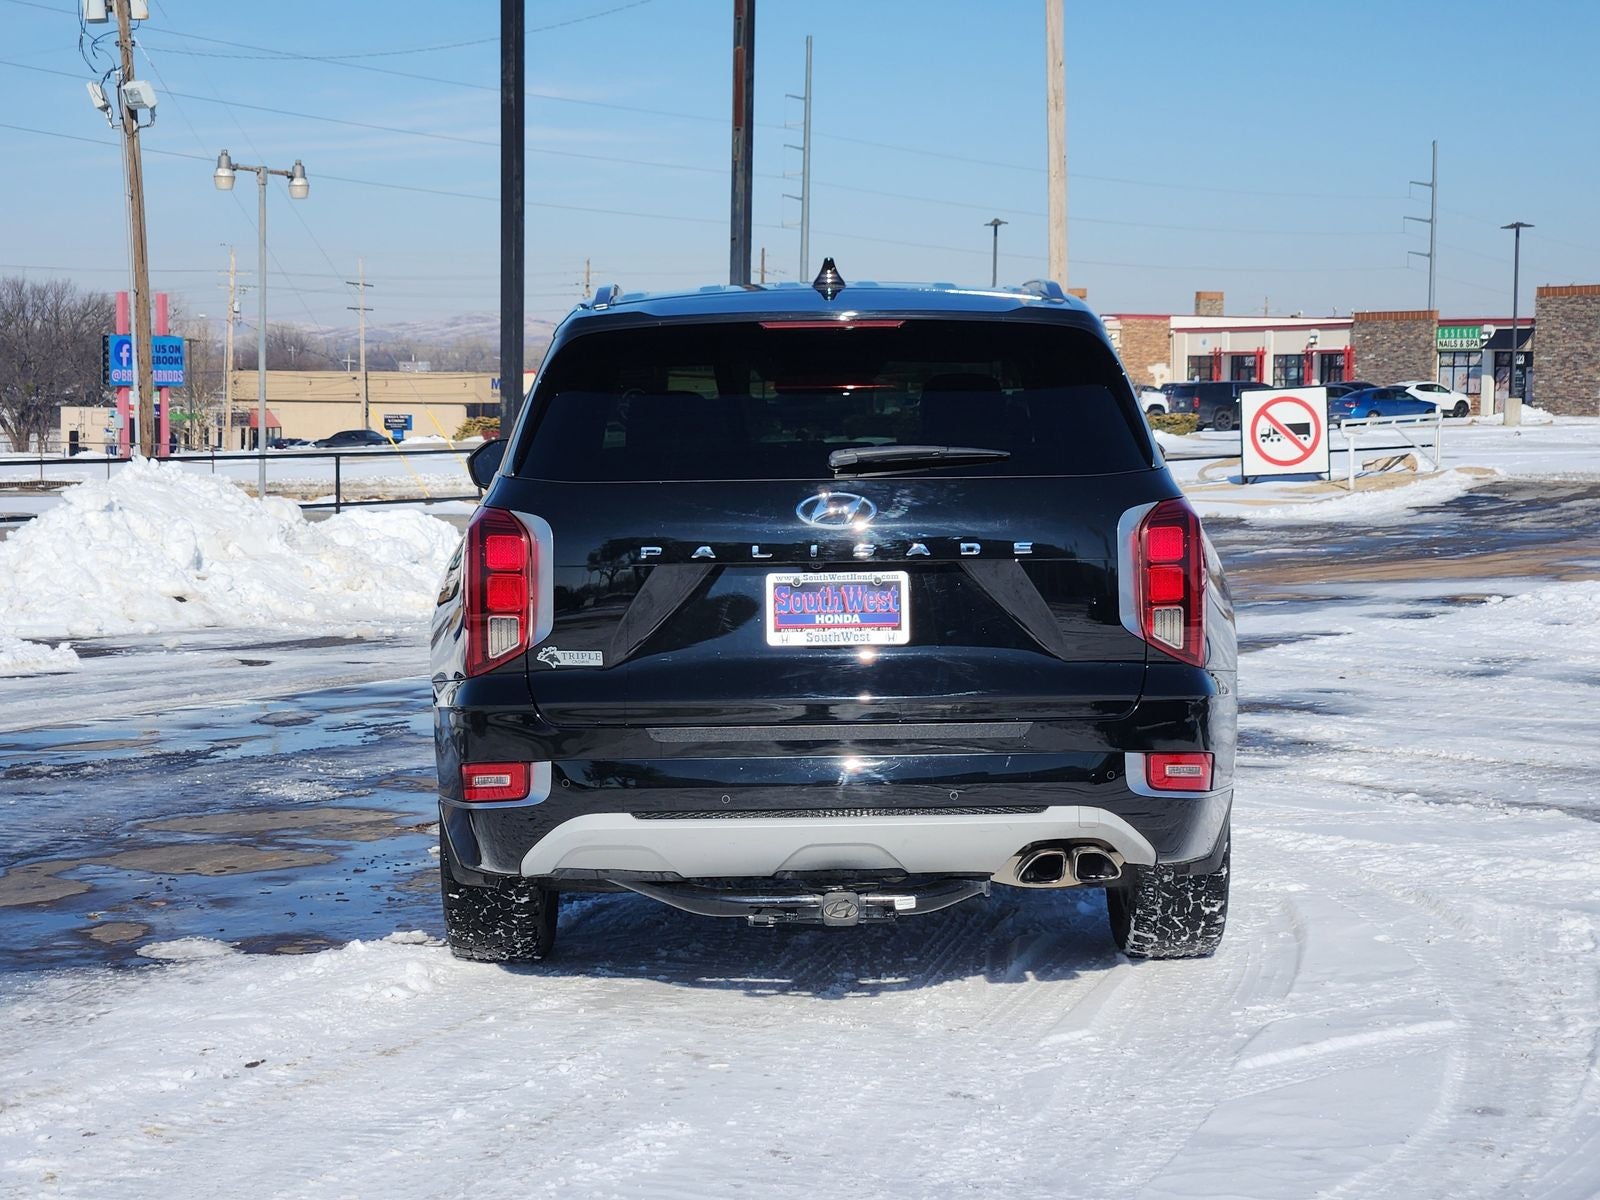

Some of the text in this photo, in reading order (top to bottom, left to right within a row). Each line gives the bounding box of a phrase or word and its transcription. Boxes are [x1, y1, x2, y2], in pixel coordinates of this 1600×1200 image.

[1438, 328, 1479, 338] ESSENCE
[1439, 339, 1479, 348] NAILS & SPA
[155, 344, 181, 354] US ON
[640, 542, 1033, 559] PALISADE
[774, 585, 900, 614] SouthWest
[815, 614, 861, 624] HONDA
[806, 632, 871, 643] SouthWest
[561, 652, 602, 660] TRIPLE
